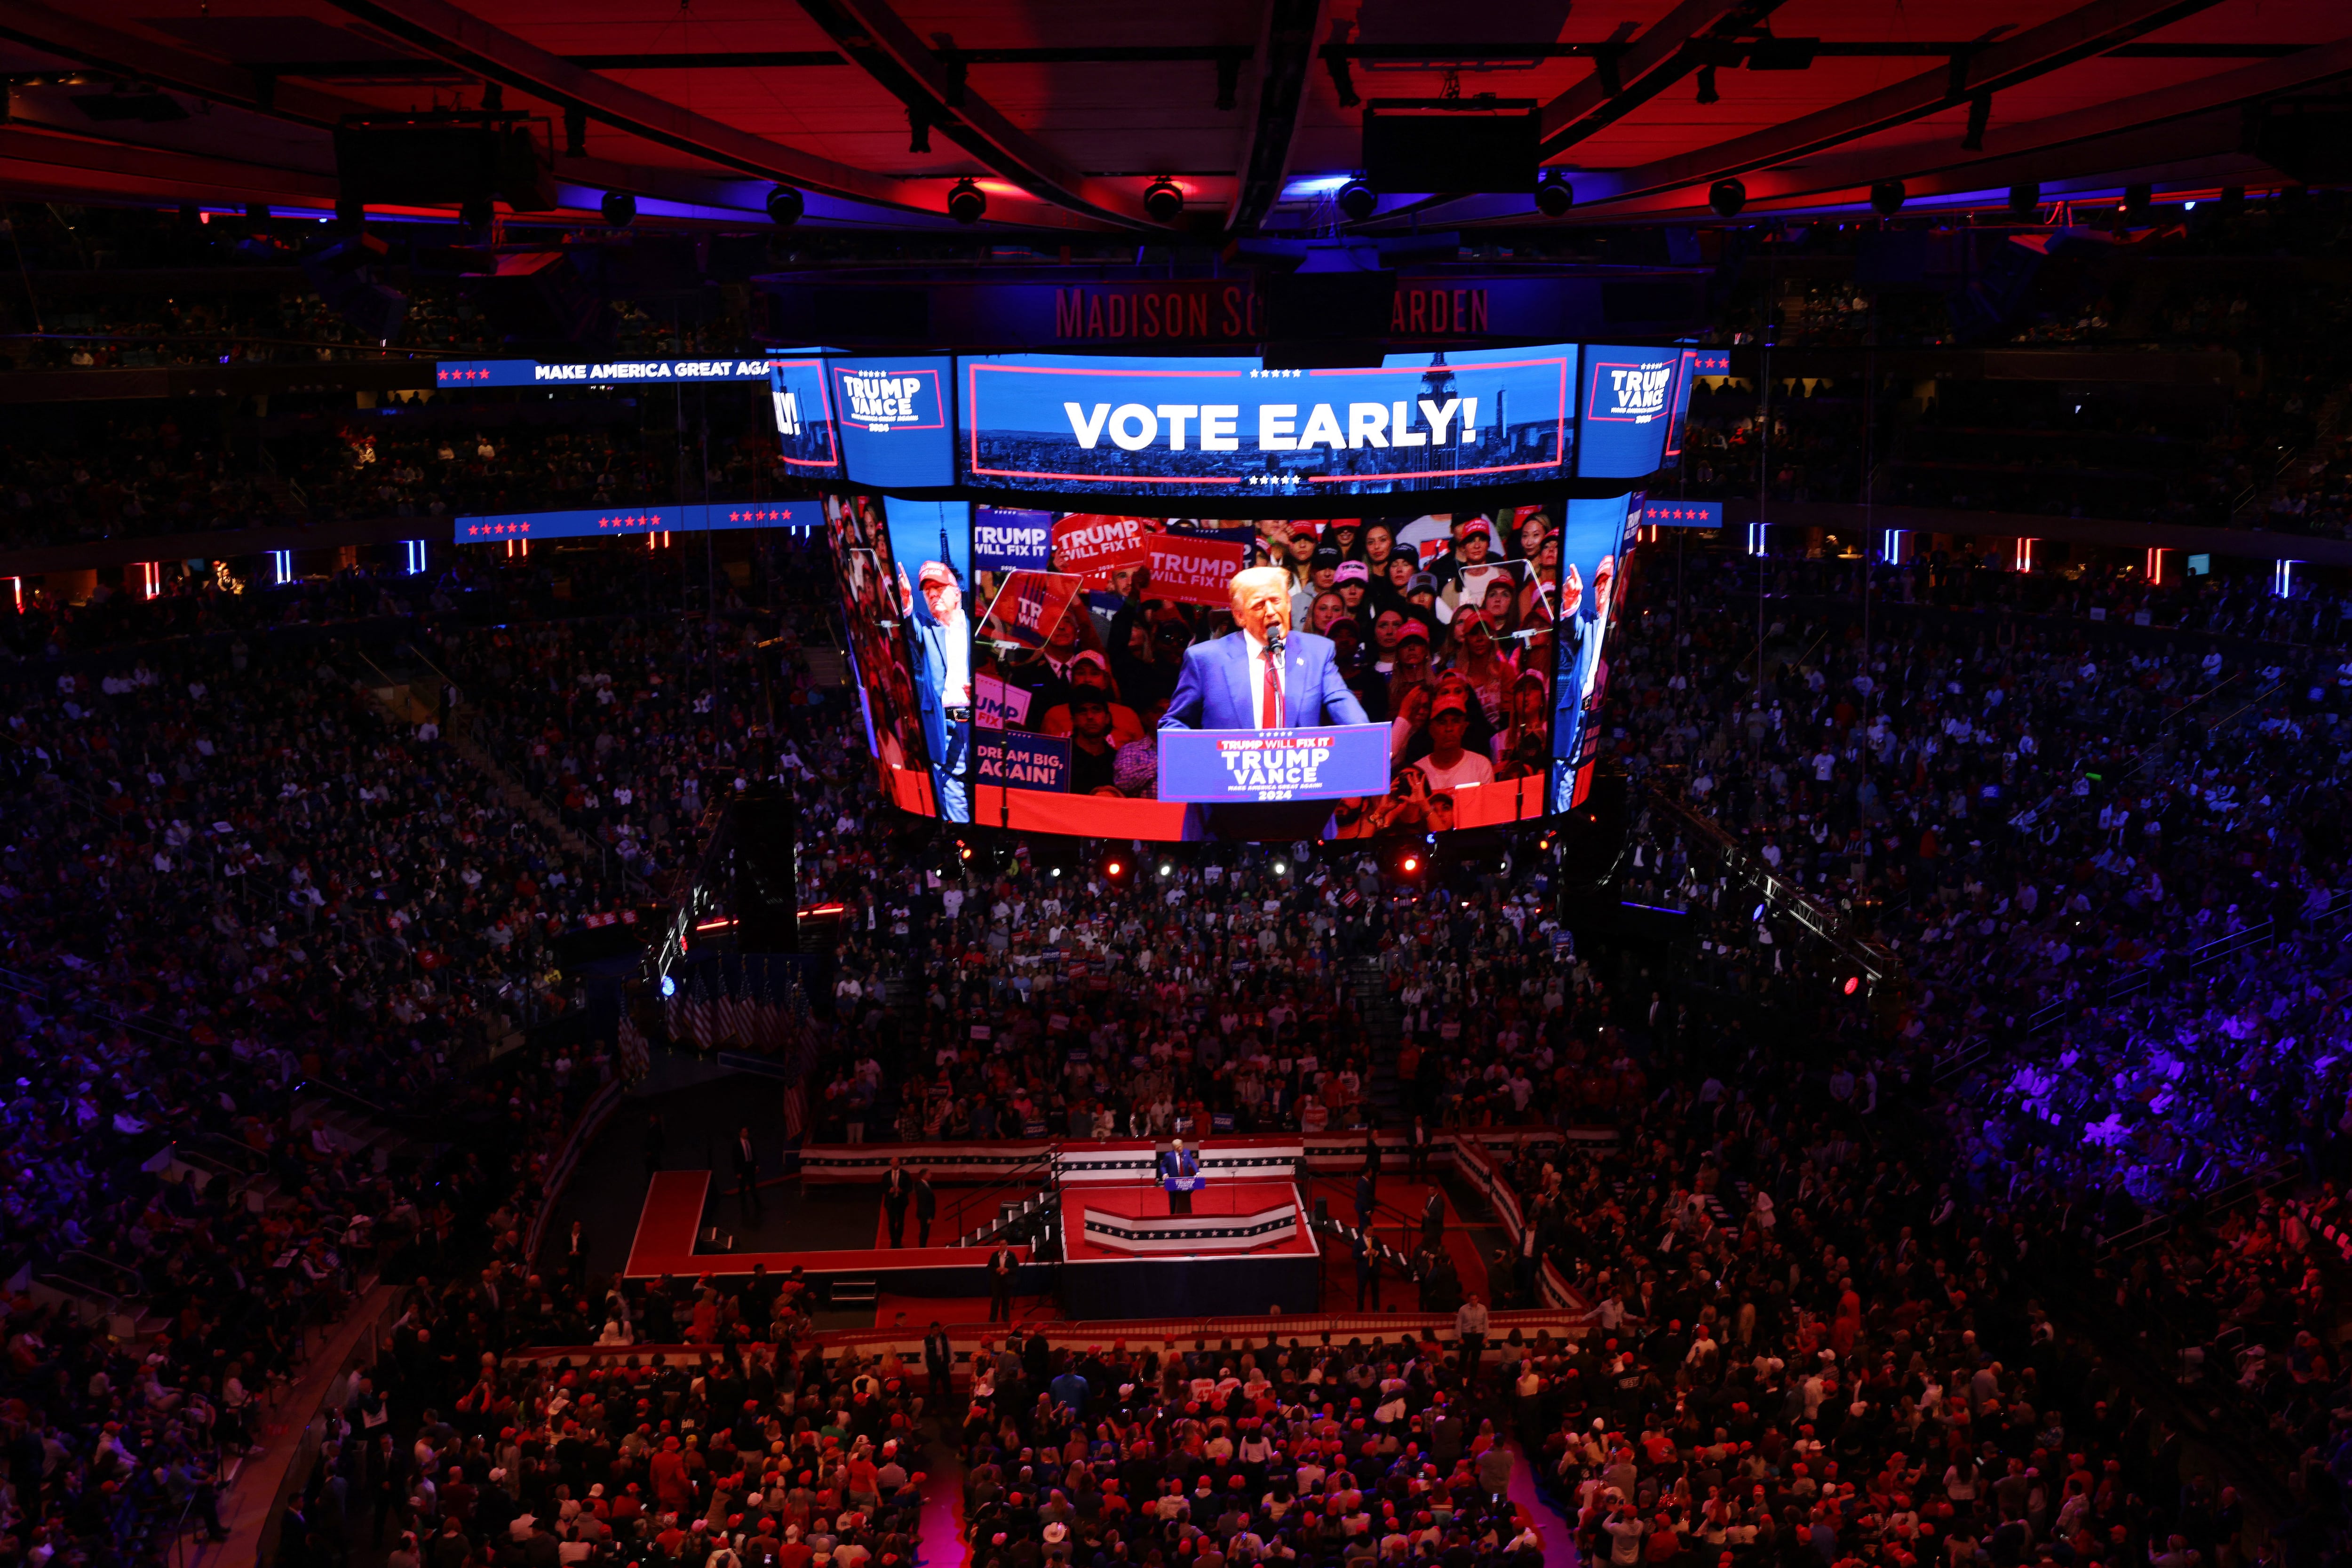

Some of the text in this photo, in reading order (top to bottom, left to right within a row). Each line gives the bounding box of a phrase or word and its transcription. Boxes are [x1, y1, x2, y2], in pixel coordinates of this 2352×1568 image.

[1056, 288, 1208, 337] MADISON
[1390, 289, 1488, 334] ARDEN
[535, 361, 770, 380] MAKE AMERICA GREAT AGA
[1611, 368, 1670, 391] TRUMP
[843, 375, 921, 399] TRUMP
[851, 396, 913, 416] VANCE
[1064, 397, 1478, 451] VOTE EARLY!
[975, 526, 1047, 545] TRUMP
[1059, 519, 1139, 550] TRUMP
[1007, 545, 1030, 556] FIX
[1033, 545, 1047, 557] IT
[1100, 540, 1125, 554] FIX
[1128, 537, 1141, 549] IT
[1149, 551, 1237, 577] TRUMP
[1150, 570, 1186, 584] WILL
[1191, 574, 1215, 588] FIX
[975, 694, 1019, 720] UMP
[978, 711, 1000, 727] FIX
[1221, 737, 1330, 750] TRUMP WILL FIX IT
[977, 745, 1064, 770] DREAM BIG,
[1221, 748, 1330, 770] TRUMP
[978, 759, 1057, 785] AGAIN!
[1233, 767, 1317, 785] VANCE
[1258, 790, 1293, 801] 2024
